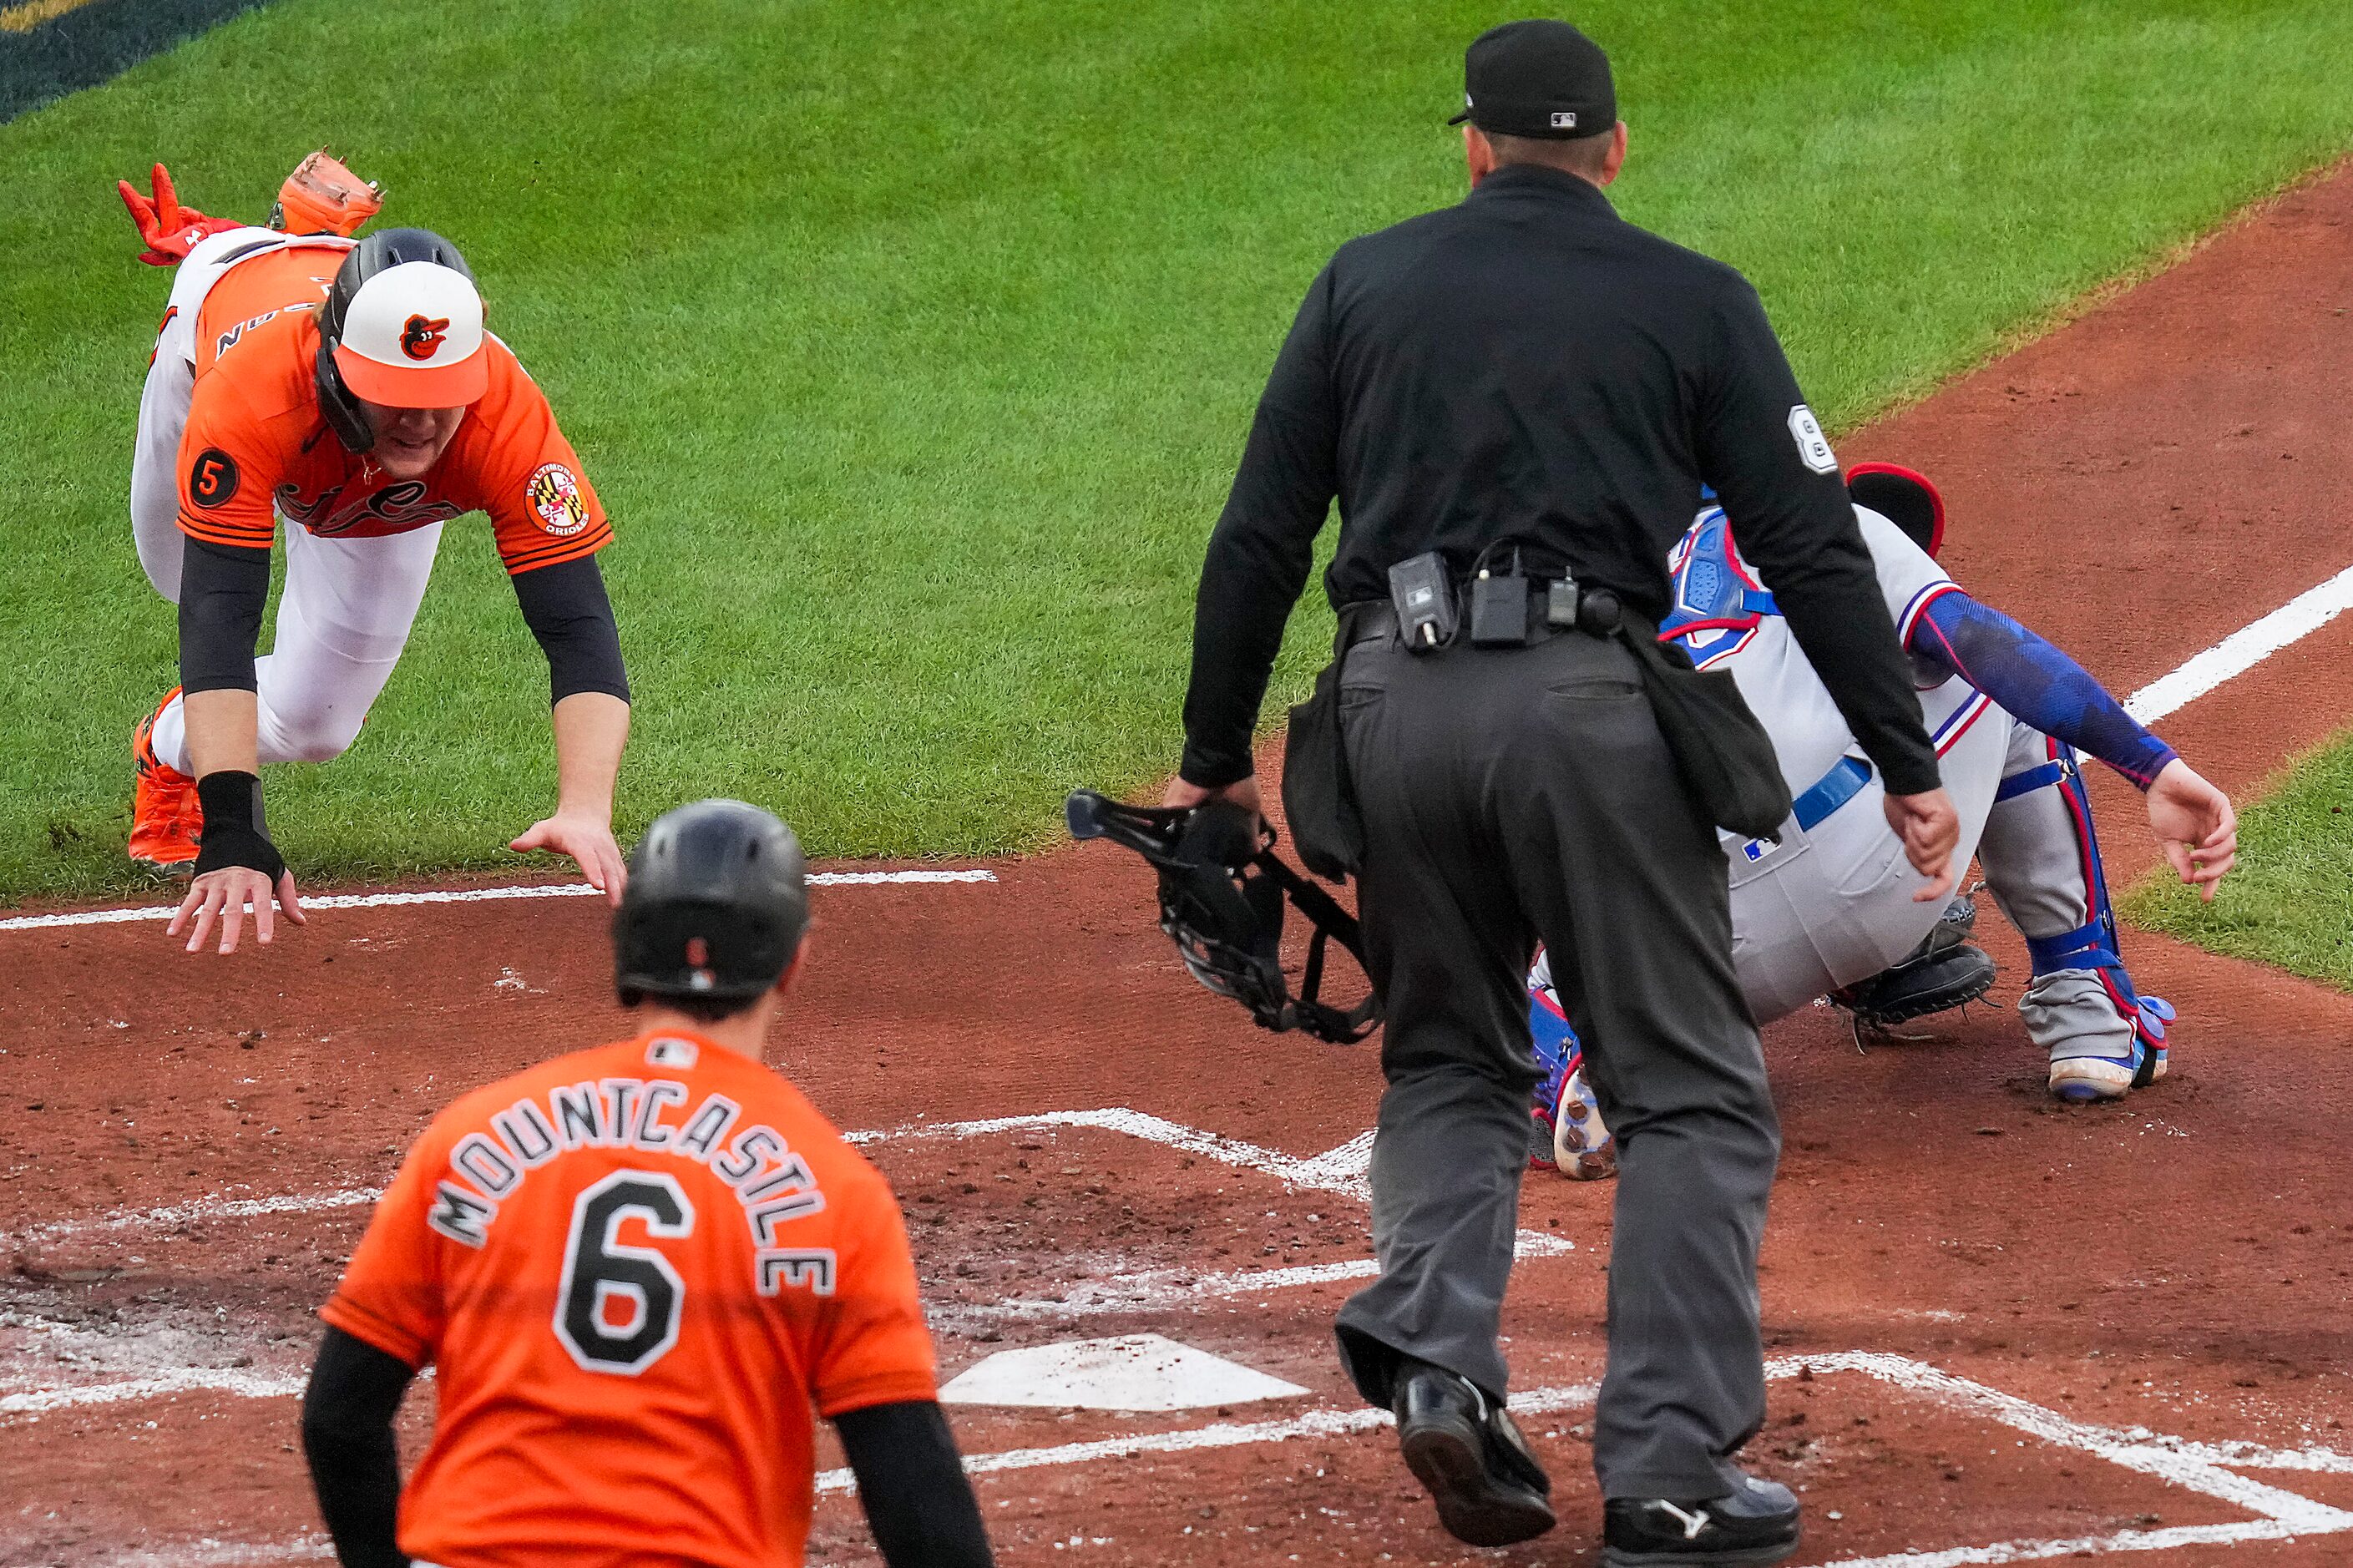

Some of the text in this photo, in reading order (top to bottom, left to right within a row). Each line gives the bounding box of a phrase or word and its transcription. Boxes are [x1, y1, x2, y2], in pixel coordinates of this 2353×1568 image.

[199, 459, 224, 496] 5
[428, 1077, 837, 1297] MOUNTCASTLE
[552, 1169, 695, 1376] 6
